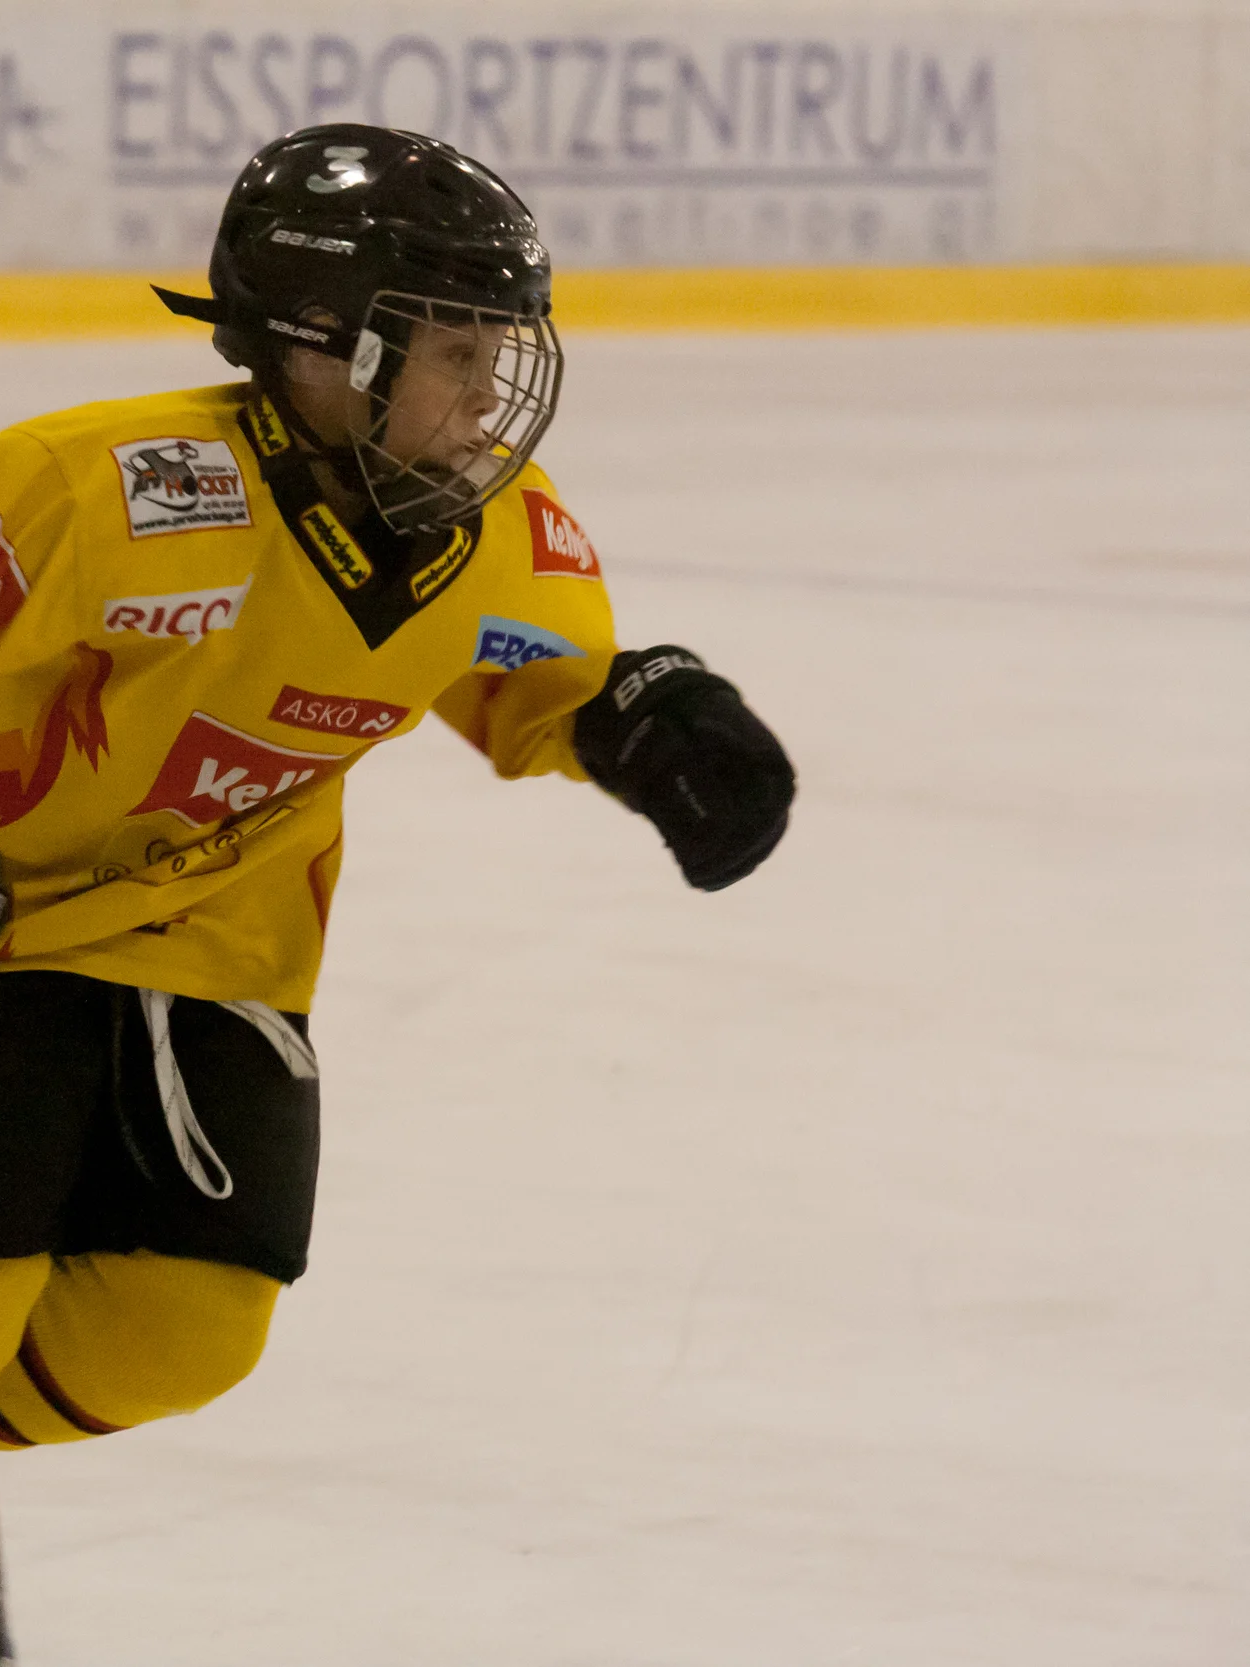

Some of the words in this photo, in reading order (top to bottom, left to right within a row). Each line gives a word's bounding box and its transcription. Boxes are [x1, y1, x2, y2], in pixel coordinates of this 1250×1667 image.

[109, 32, 997, 160] EISSPORTZENTRUM
[306, 145, 371, 194] 3
[280, 699, 358, 729] ASKÖ
